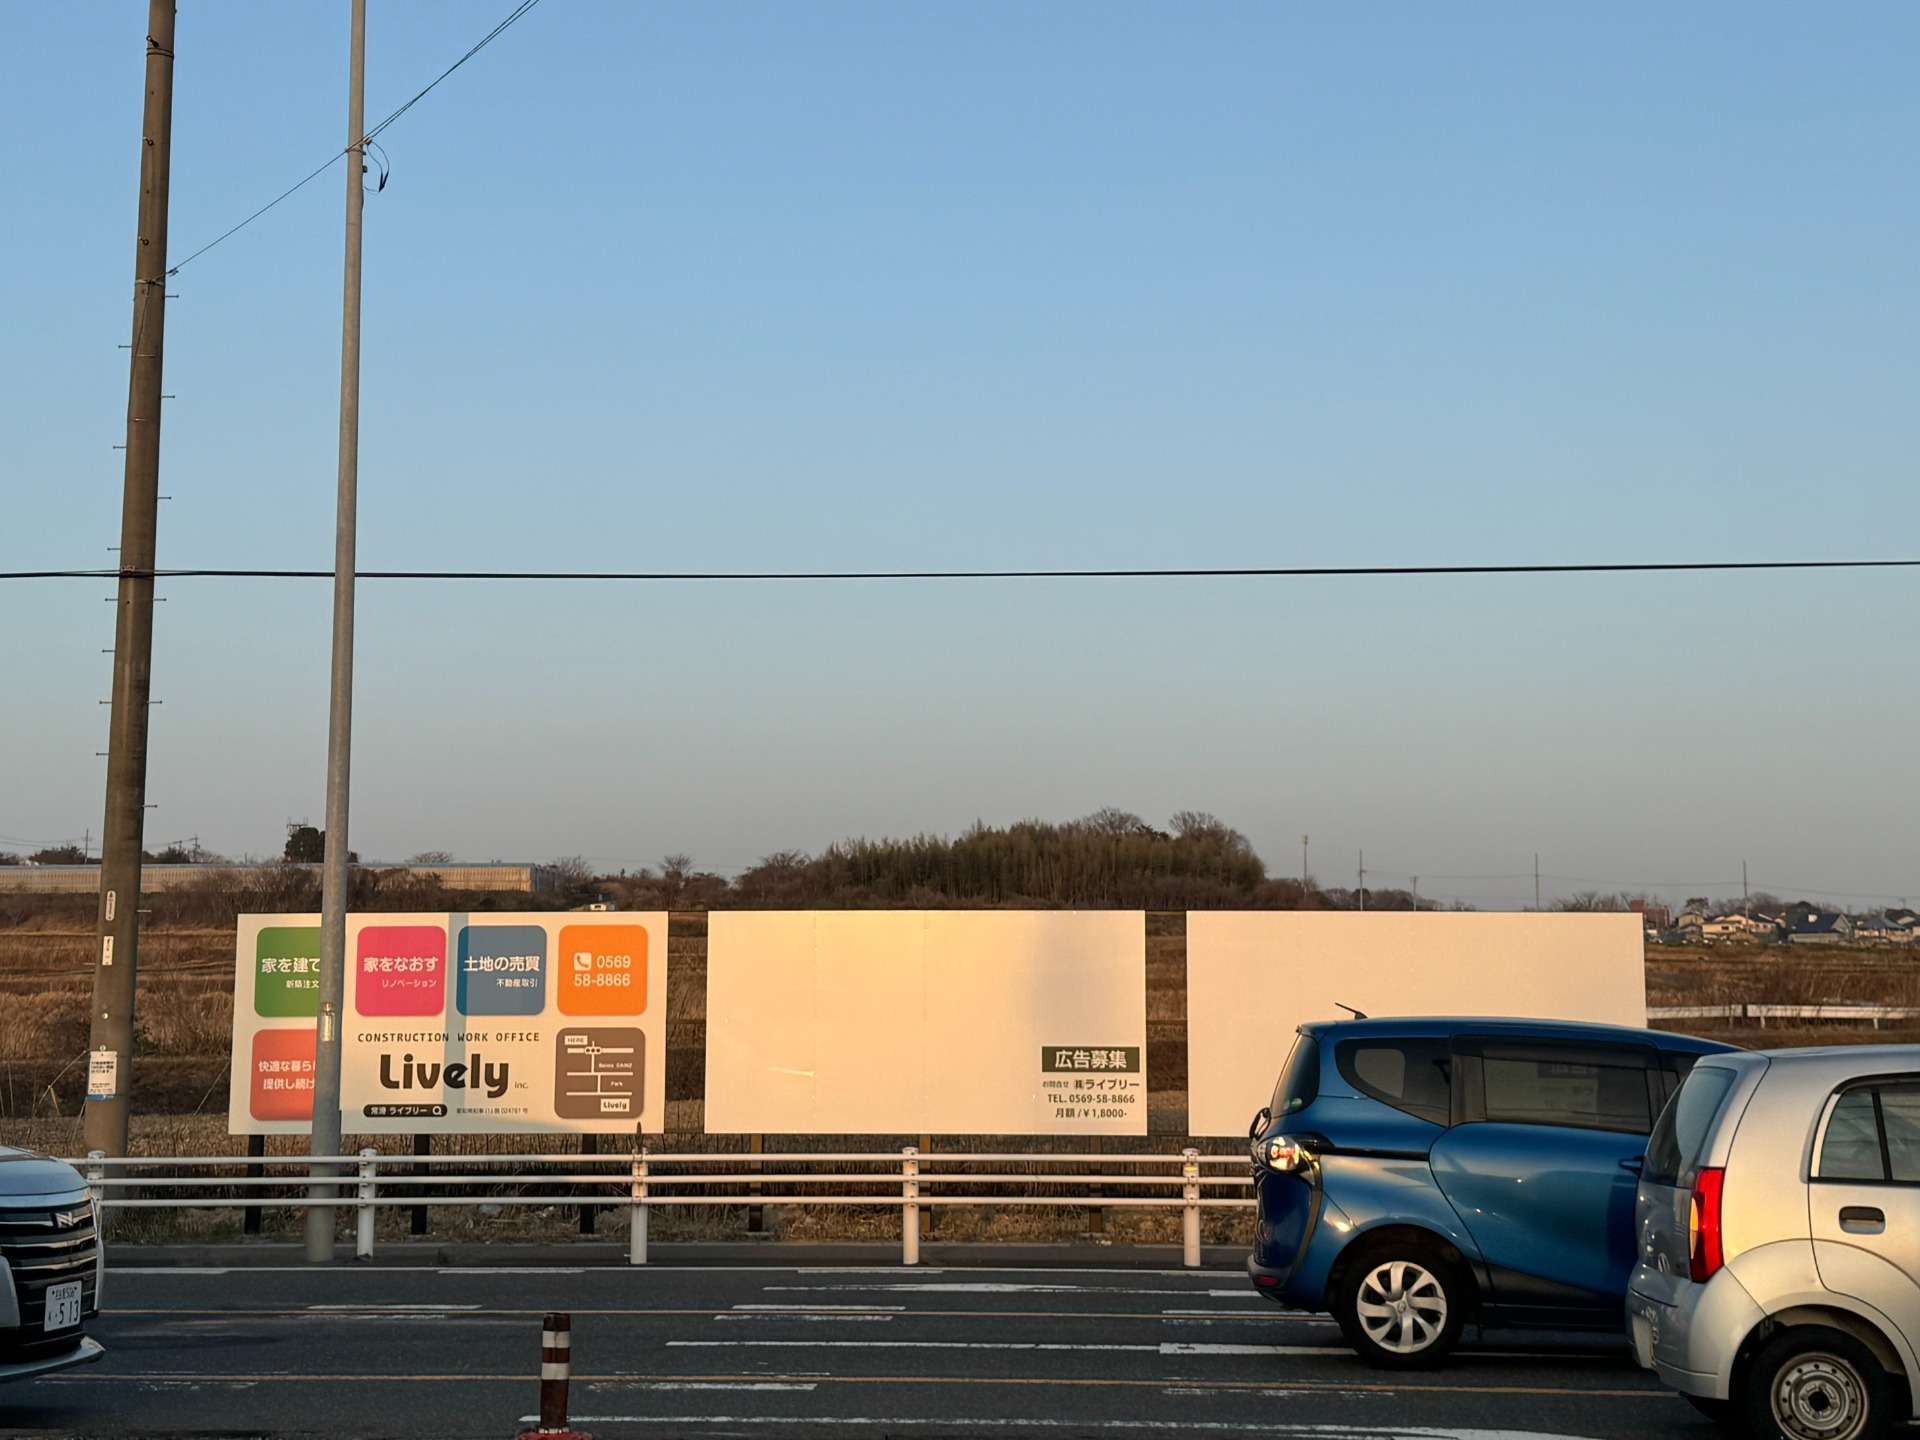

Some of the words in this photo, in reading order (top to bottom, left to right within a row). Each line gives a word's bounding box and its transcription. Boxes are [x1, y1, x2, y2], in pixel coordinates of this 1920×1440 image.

[261, 957, 321, 973] 家を建て
[363, 956, 439, 973] 家をなおす
[463, 955, 540, 972] 土地の売買
[596, 955, 632, 969] 0569
[286, 979, 320, 989] 新築注文
[381, 979, 438, 988] リノベーション
[495, 978, 538, 988] 不動産取引
[574, 973, 631, 987] 58-8866
[357, 1032, 449, 1043] CONSTRUCTION
[457, 1032, 489, 1042] WORK
[495, 1032, 540, 1042] OFFICE
[1055, 1049, 1127, 1069] 広告募集
[380, 1053, 509, 1098] Lively
[263, 1078, 315, 1090] 提供し続け
[389, 1106, 428, 1116] ライブリー
